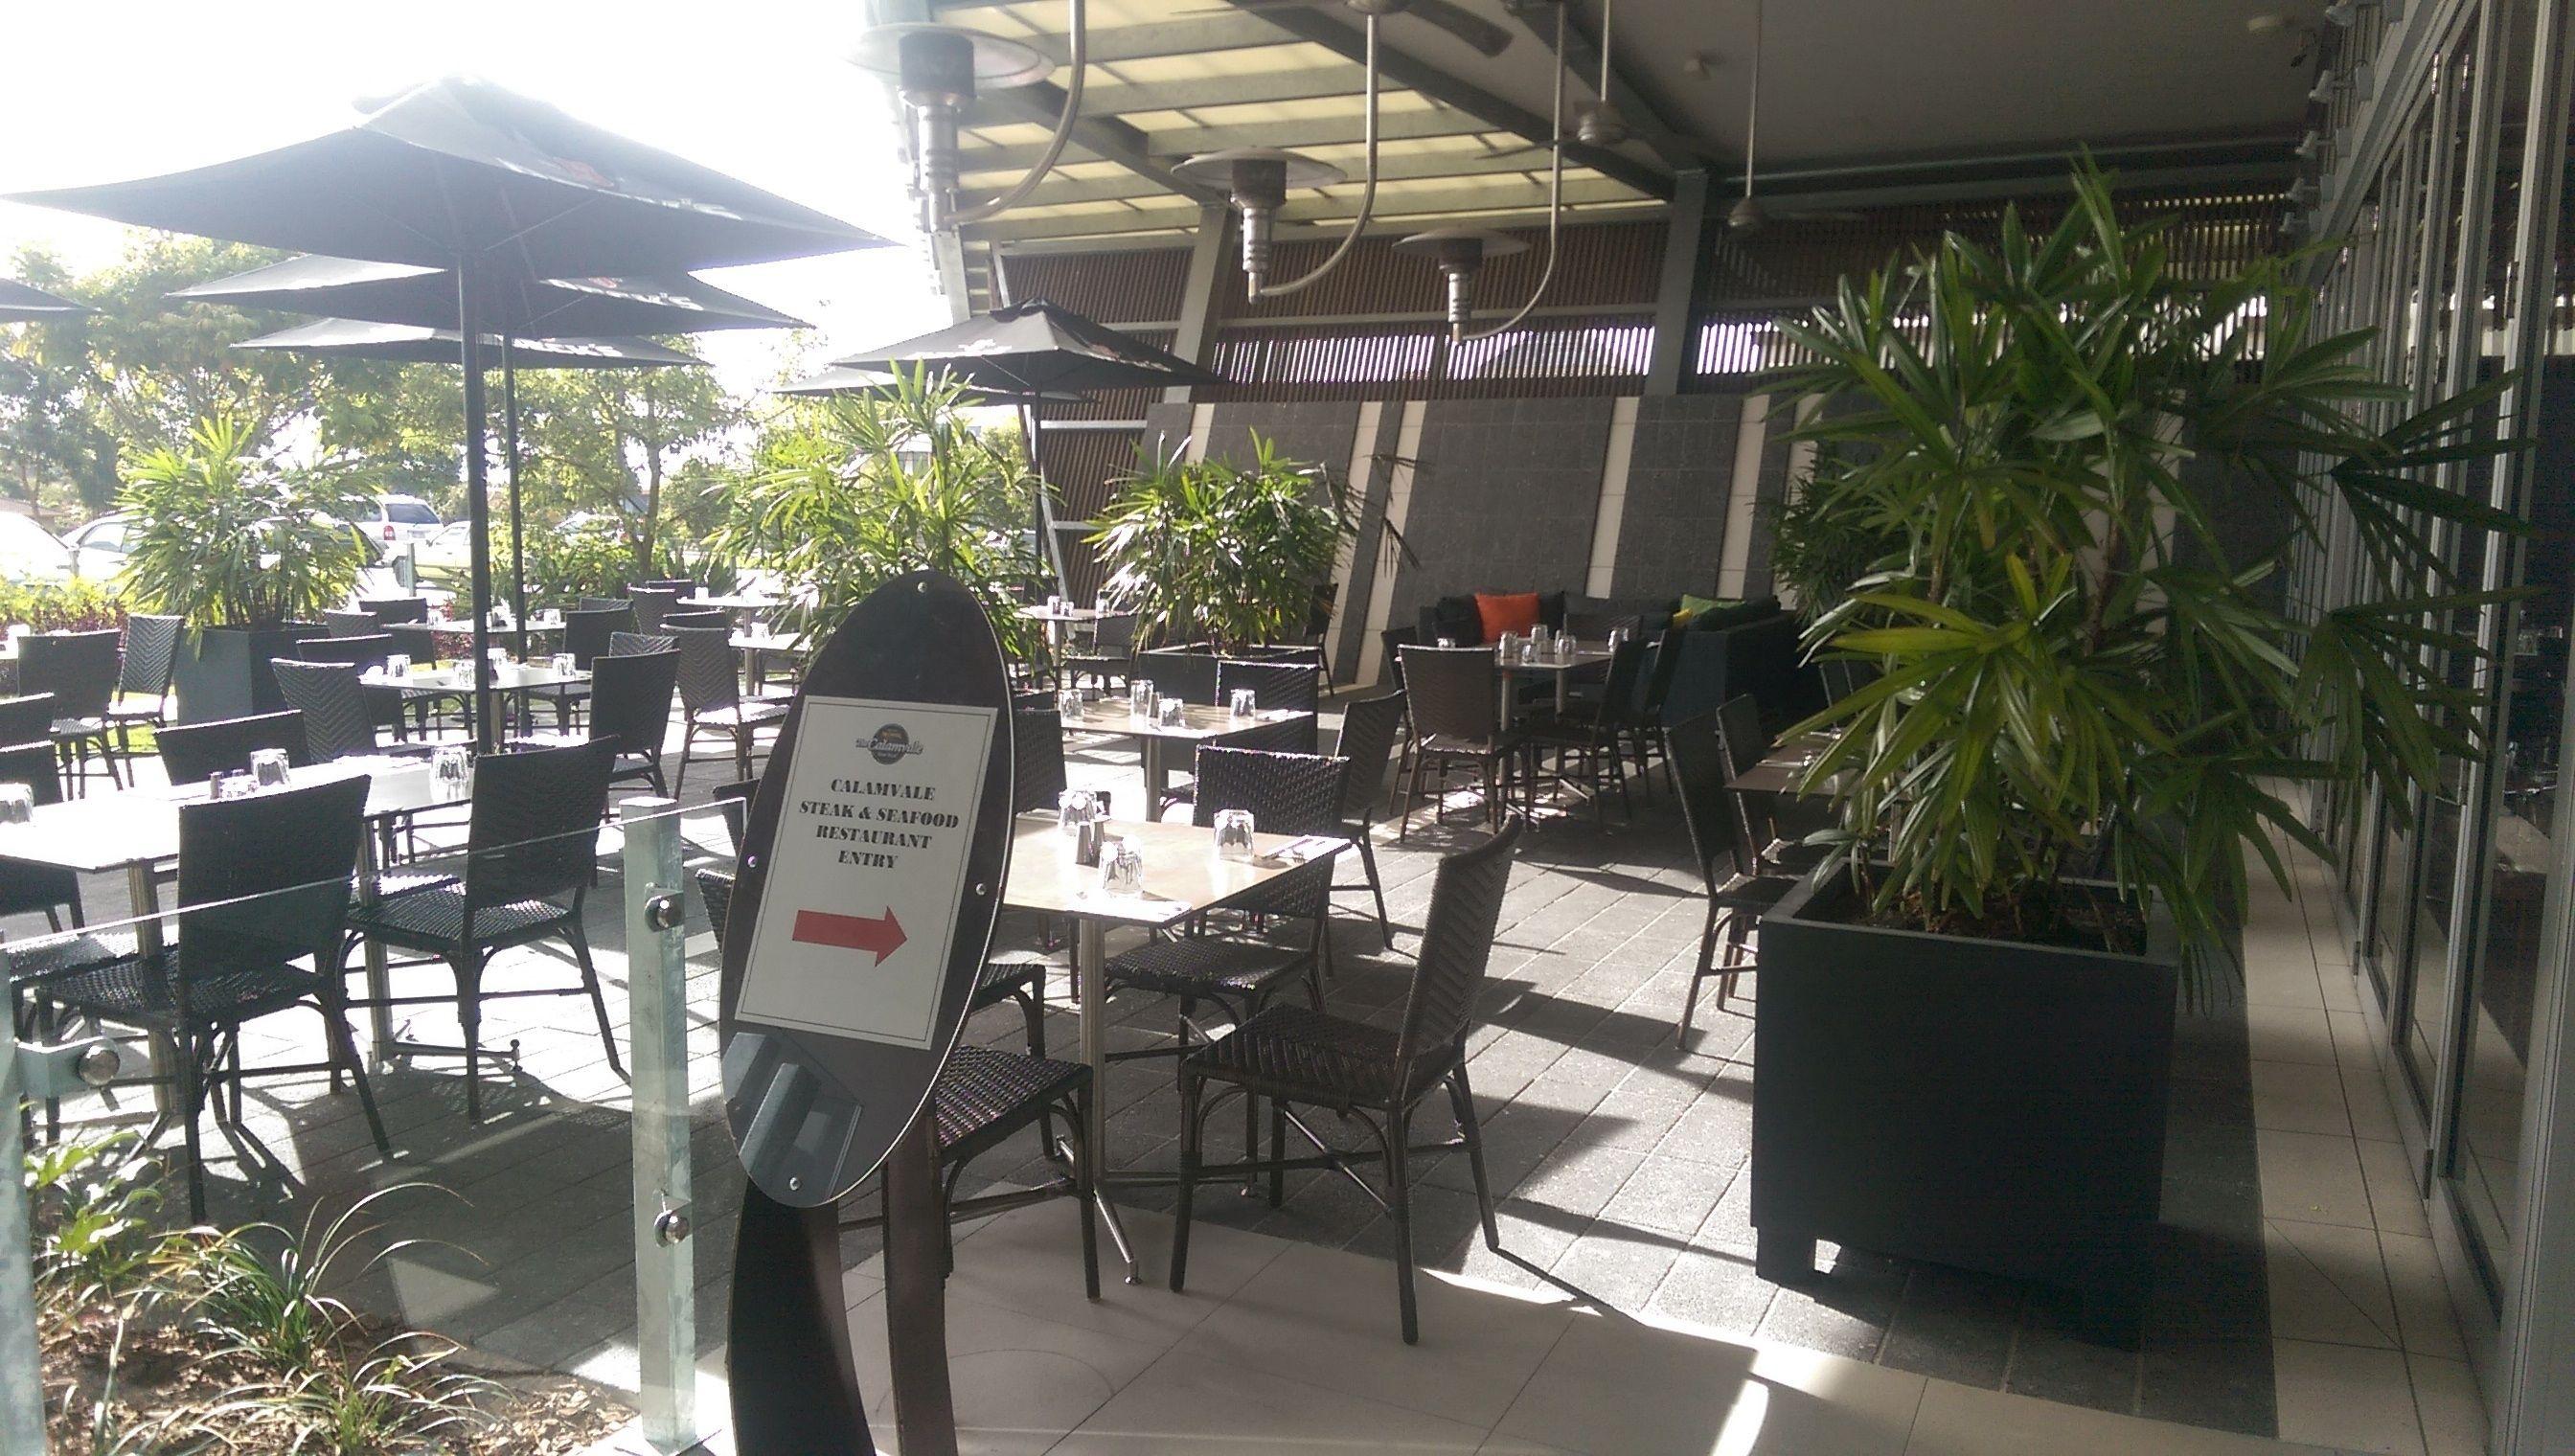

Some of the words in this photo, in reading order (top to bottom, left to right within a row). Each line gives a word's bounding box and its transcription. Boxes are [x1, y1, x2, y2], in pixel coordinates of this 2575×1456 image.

[831, 779, 935, 801] CALAMVALE
[799, 800, 855, 818] STEAK
[858, 806, 871, 820] &
[876, 808, 959, 829] SEAFOOD
[816, 825, 932, 849] RESTAURANT
[838, 850, 898, 869] ENTRY
